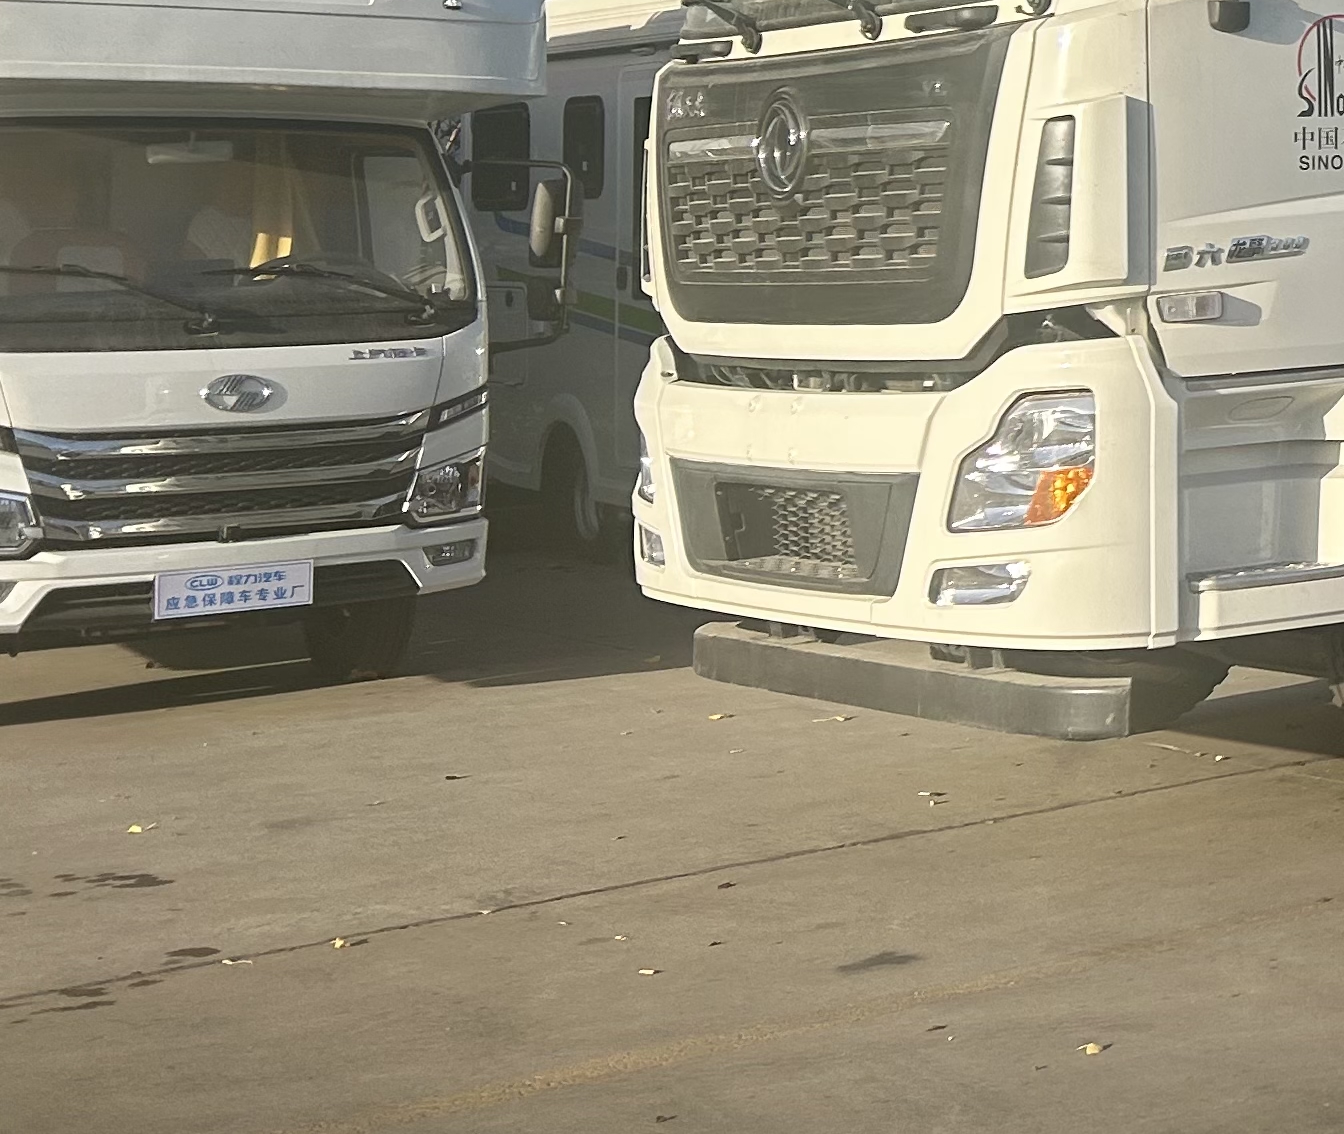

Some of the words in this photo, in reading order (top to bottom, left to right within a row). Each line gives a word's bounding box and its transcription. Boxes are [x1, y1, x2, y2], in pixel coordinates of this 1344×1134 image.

[189, 577, 219, 588] CLW
[226, 570, 288, 586] 程力汽车
[164, 584, 305, 611] 应急保障车专业厂
